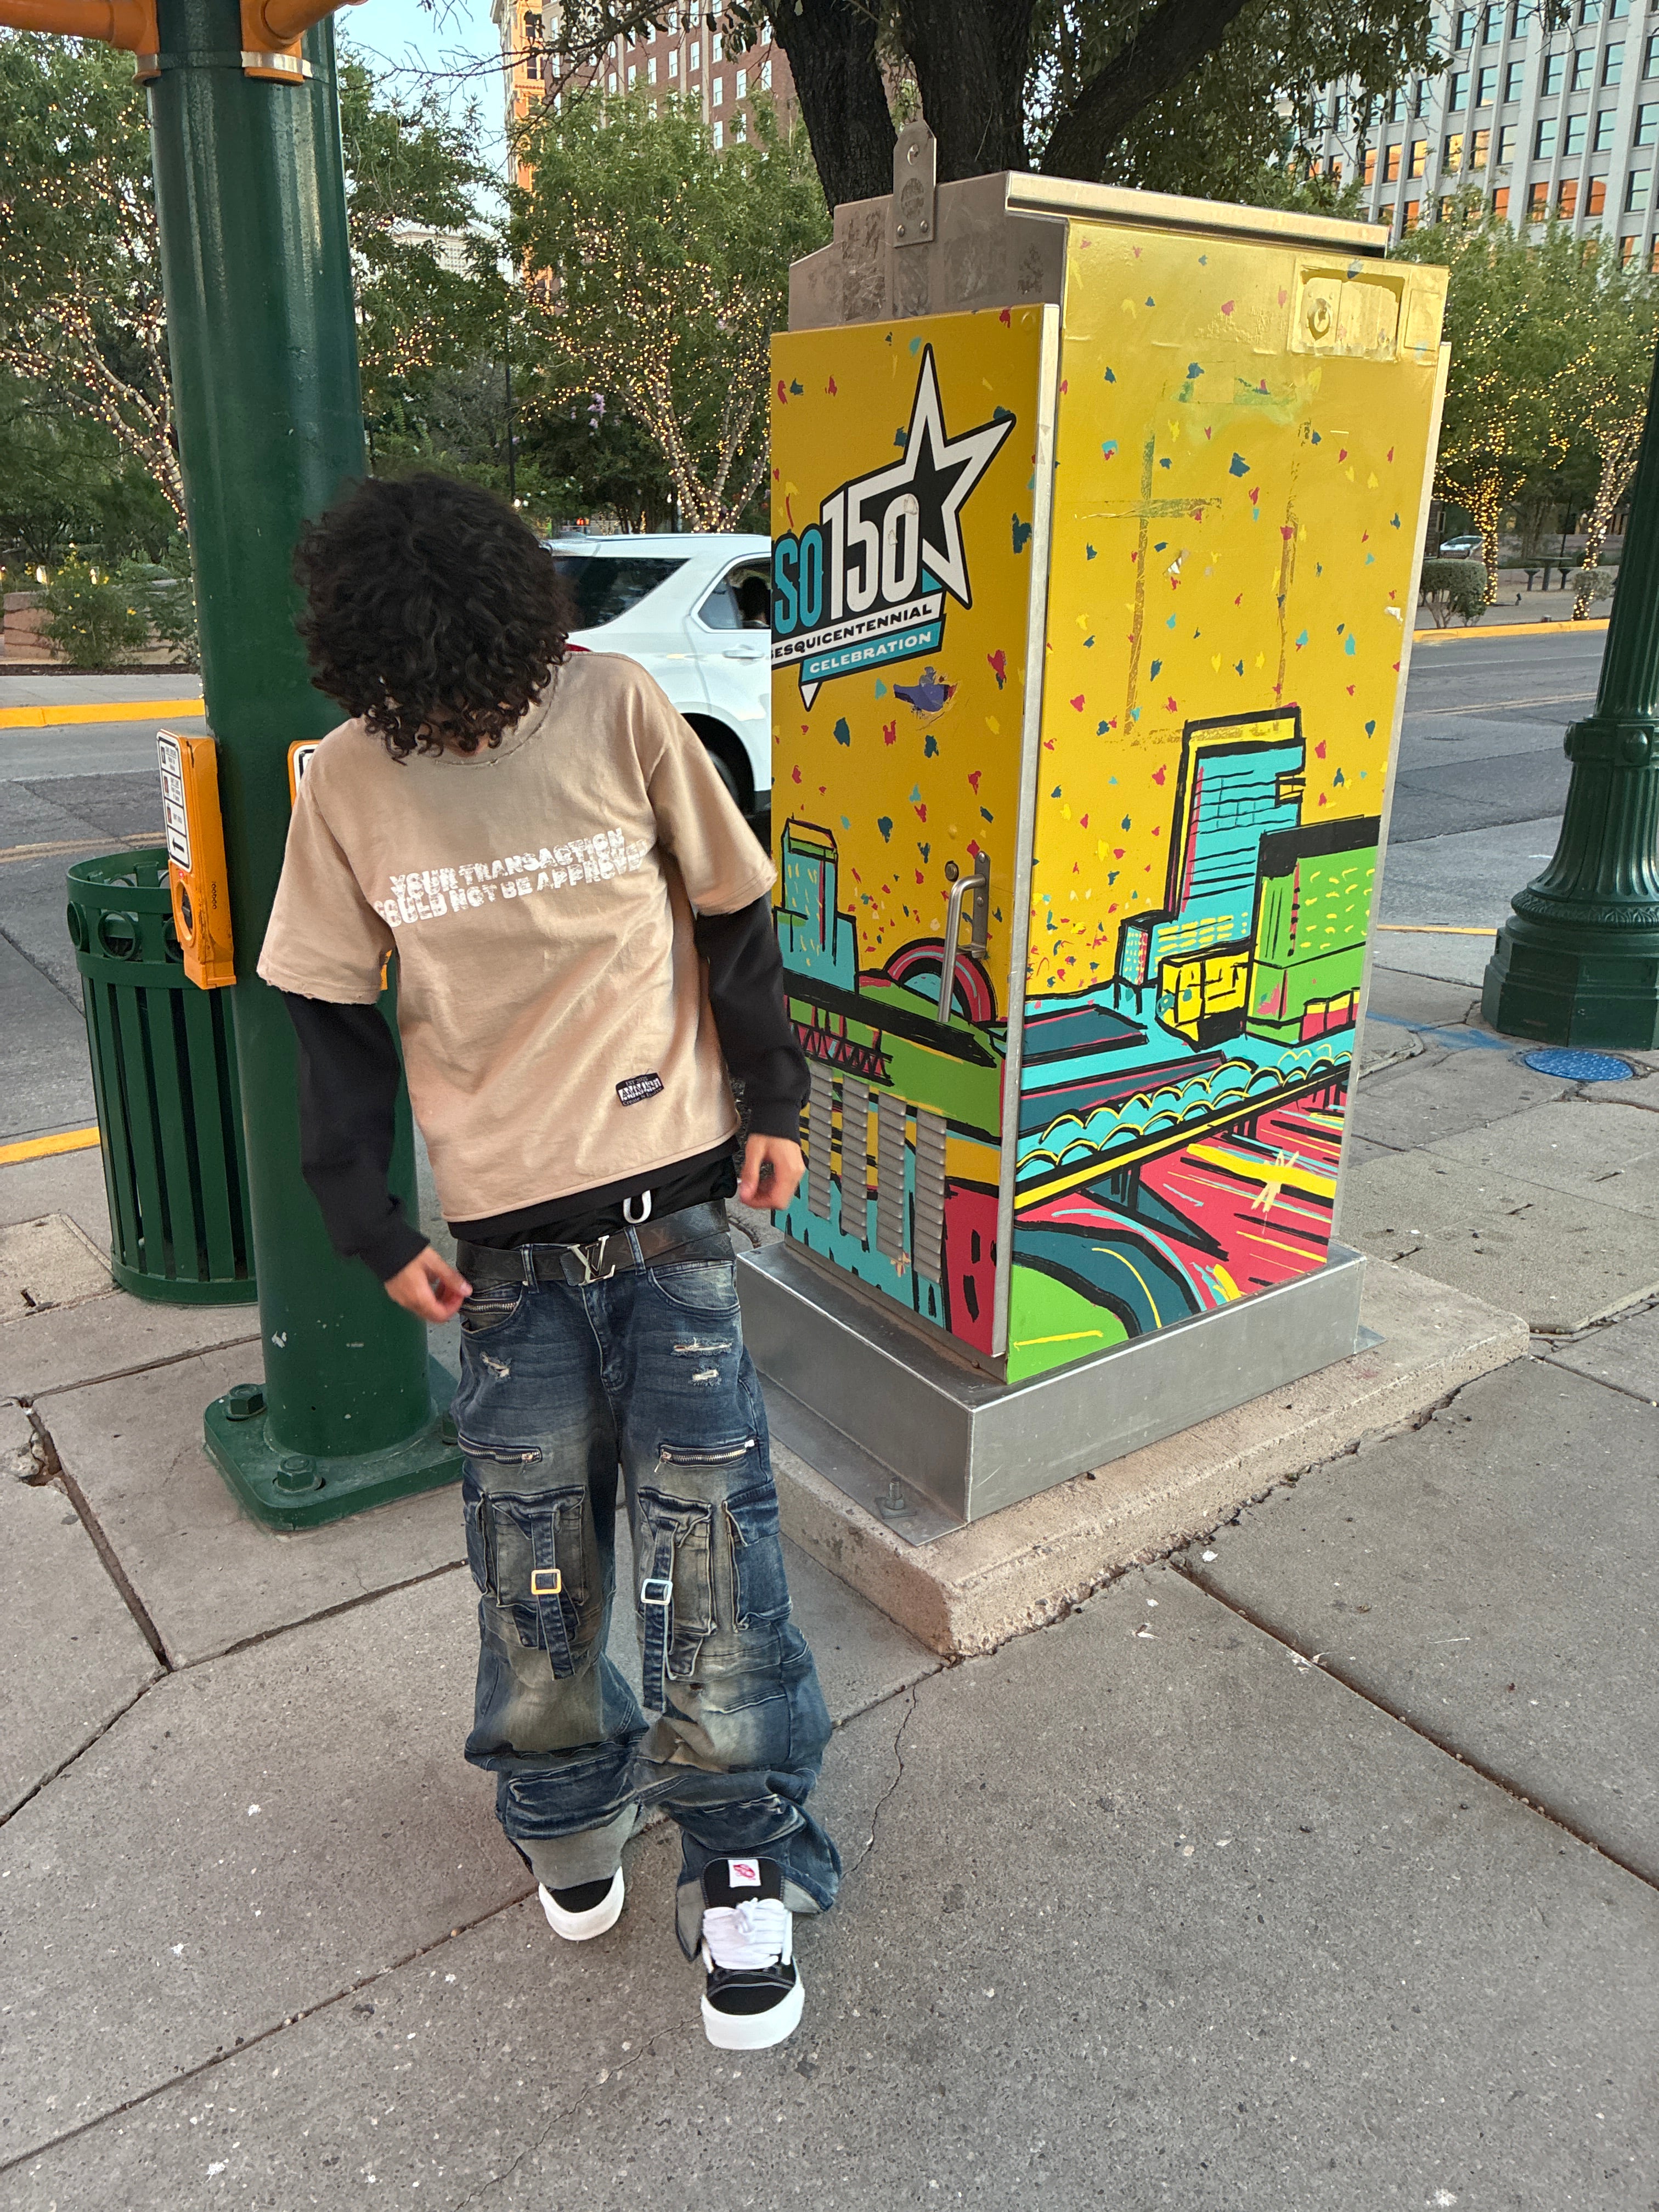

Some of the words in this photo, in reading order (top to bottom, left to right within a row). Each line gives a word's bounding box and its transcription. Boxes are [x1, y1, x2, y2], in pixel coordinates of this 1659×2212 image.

[810, 631, 932, 674] CELEBRATION
[390, 867, 459, 900] YOUR
[458, 827, 624, 885] TRANSACTION
[449, 884, 497, 912] NOT
[500, 877, 533, 899] BE
